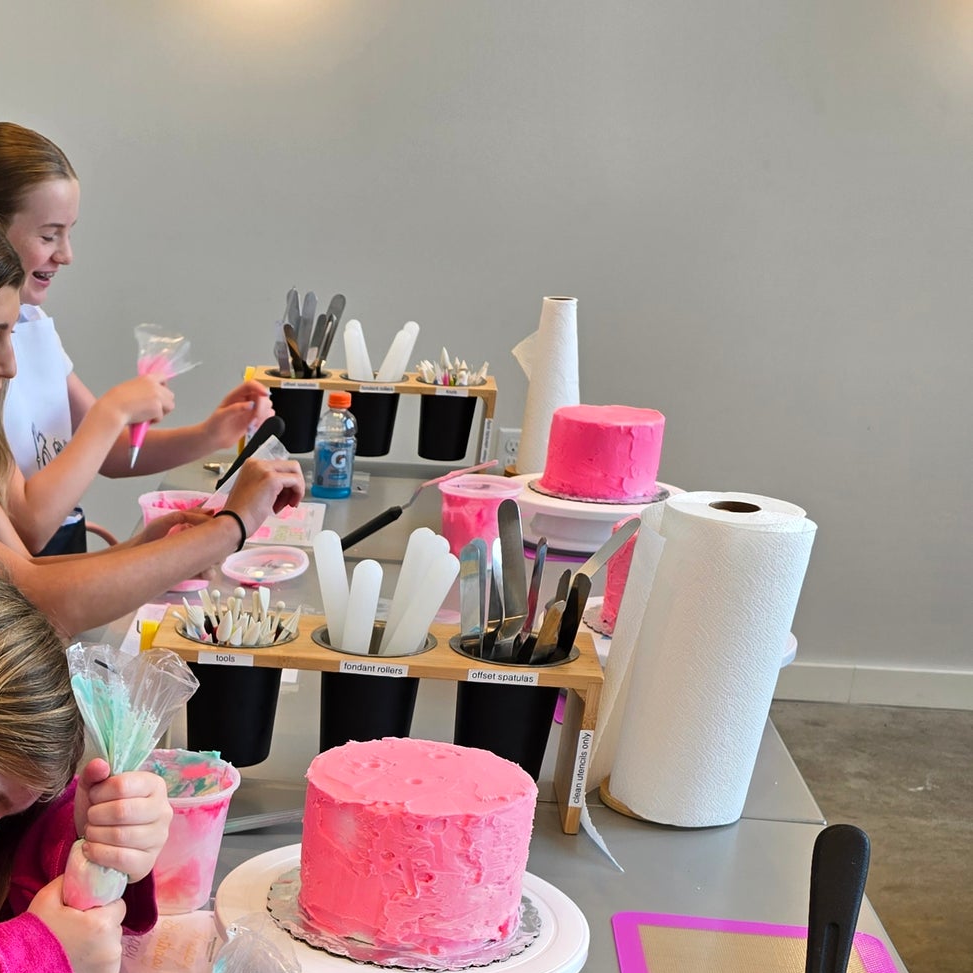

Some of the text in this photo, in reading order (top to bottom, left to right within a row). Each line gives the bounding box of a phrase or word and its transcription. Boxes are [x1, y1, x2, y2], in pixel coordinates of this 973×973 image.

[215, 654, 236, 663] tools
[343, 662, 403, 675] fondant rollers
[471, 671, 534, 683] offset spatulas
[573, 732, 592, 804] clean utencils only
